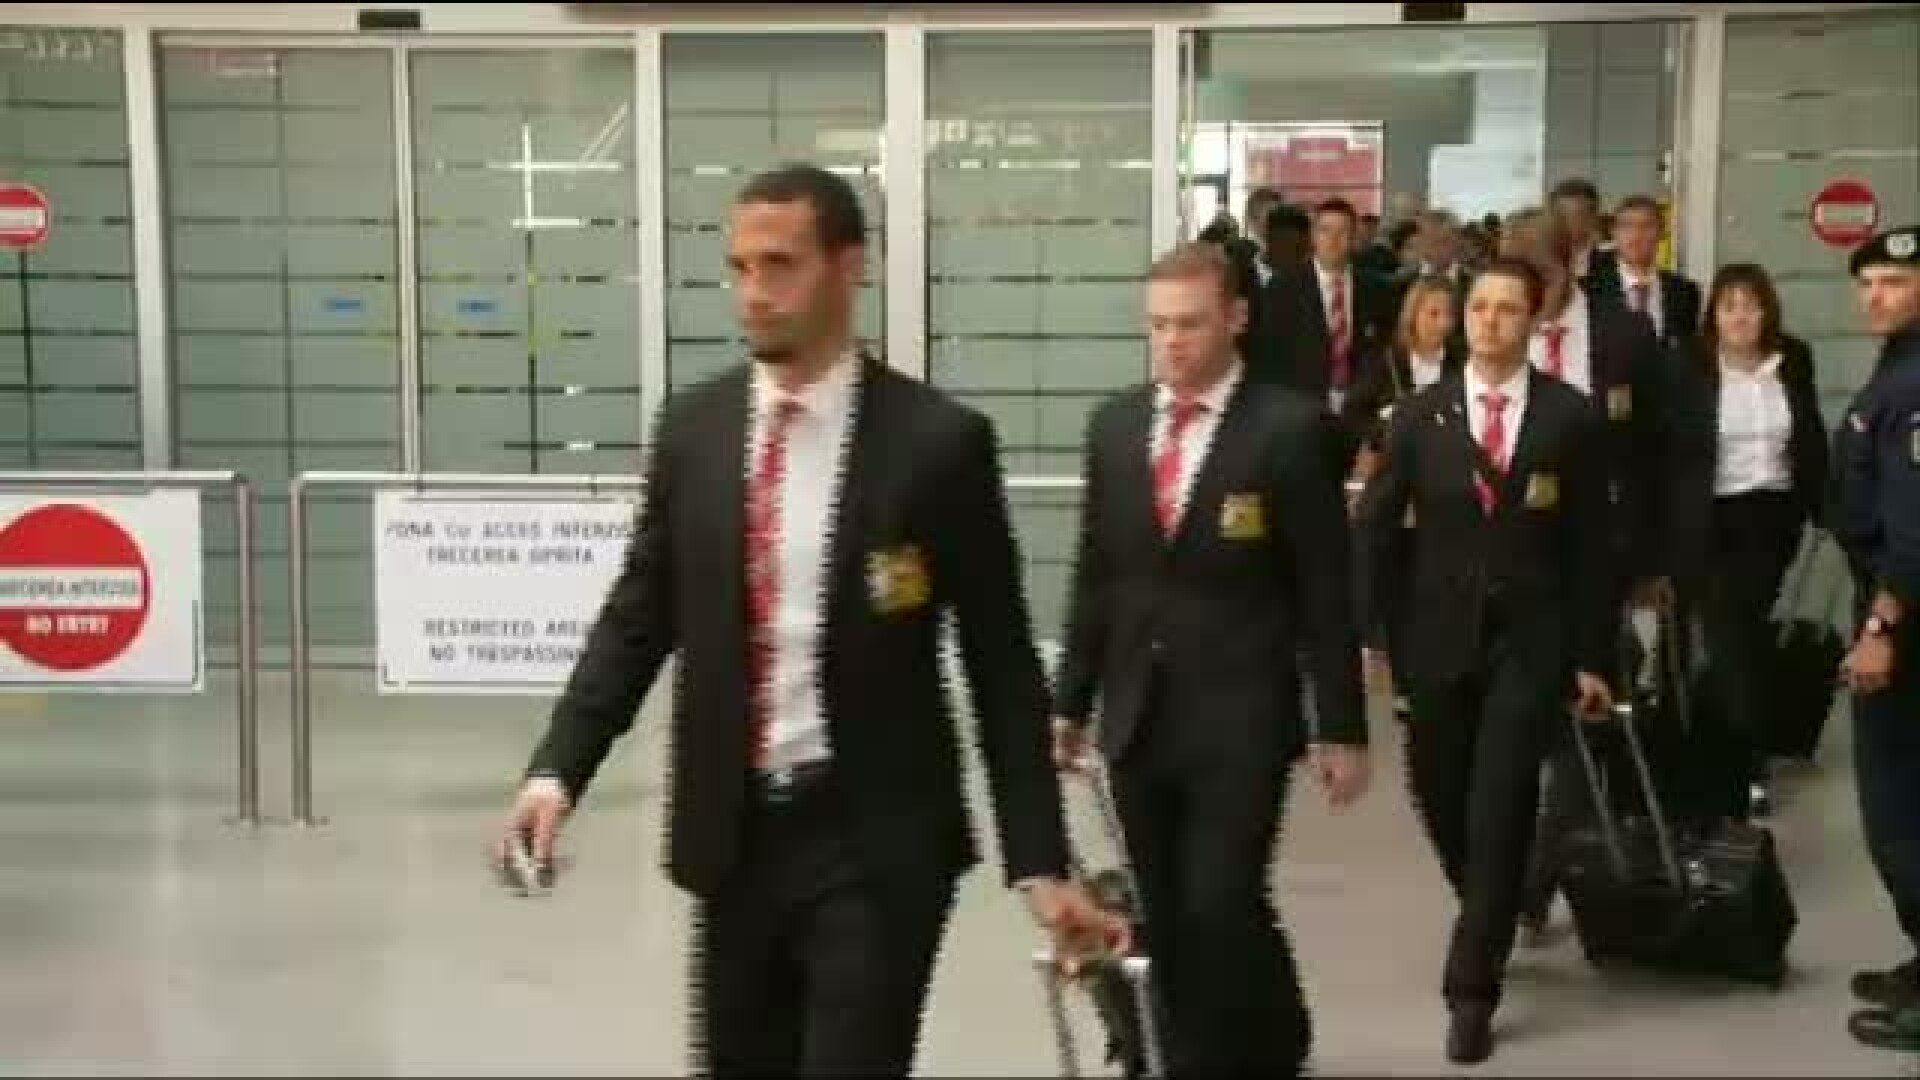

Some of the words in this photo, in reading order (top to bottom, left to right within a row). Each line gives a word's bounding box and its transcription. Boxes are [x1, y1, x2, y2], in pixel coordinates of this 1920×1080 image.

[27, 614, 52, 635] NO
[56, 614, 109, 635] ENTRY
[425, 620, 535, 637] RESTRICTED
[431, 644, 456, 661] NO
